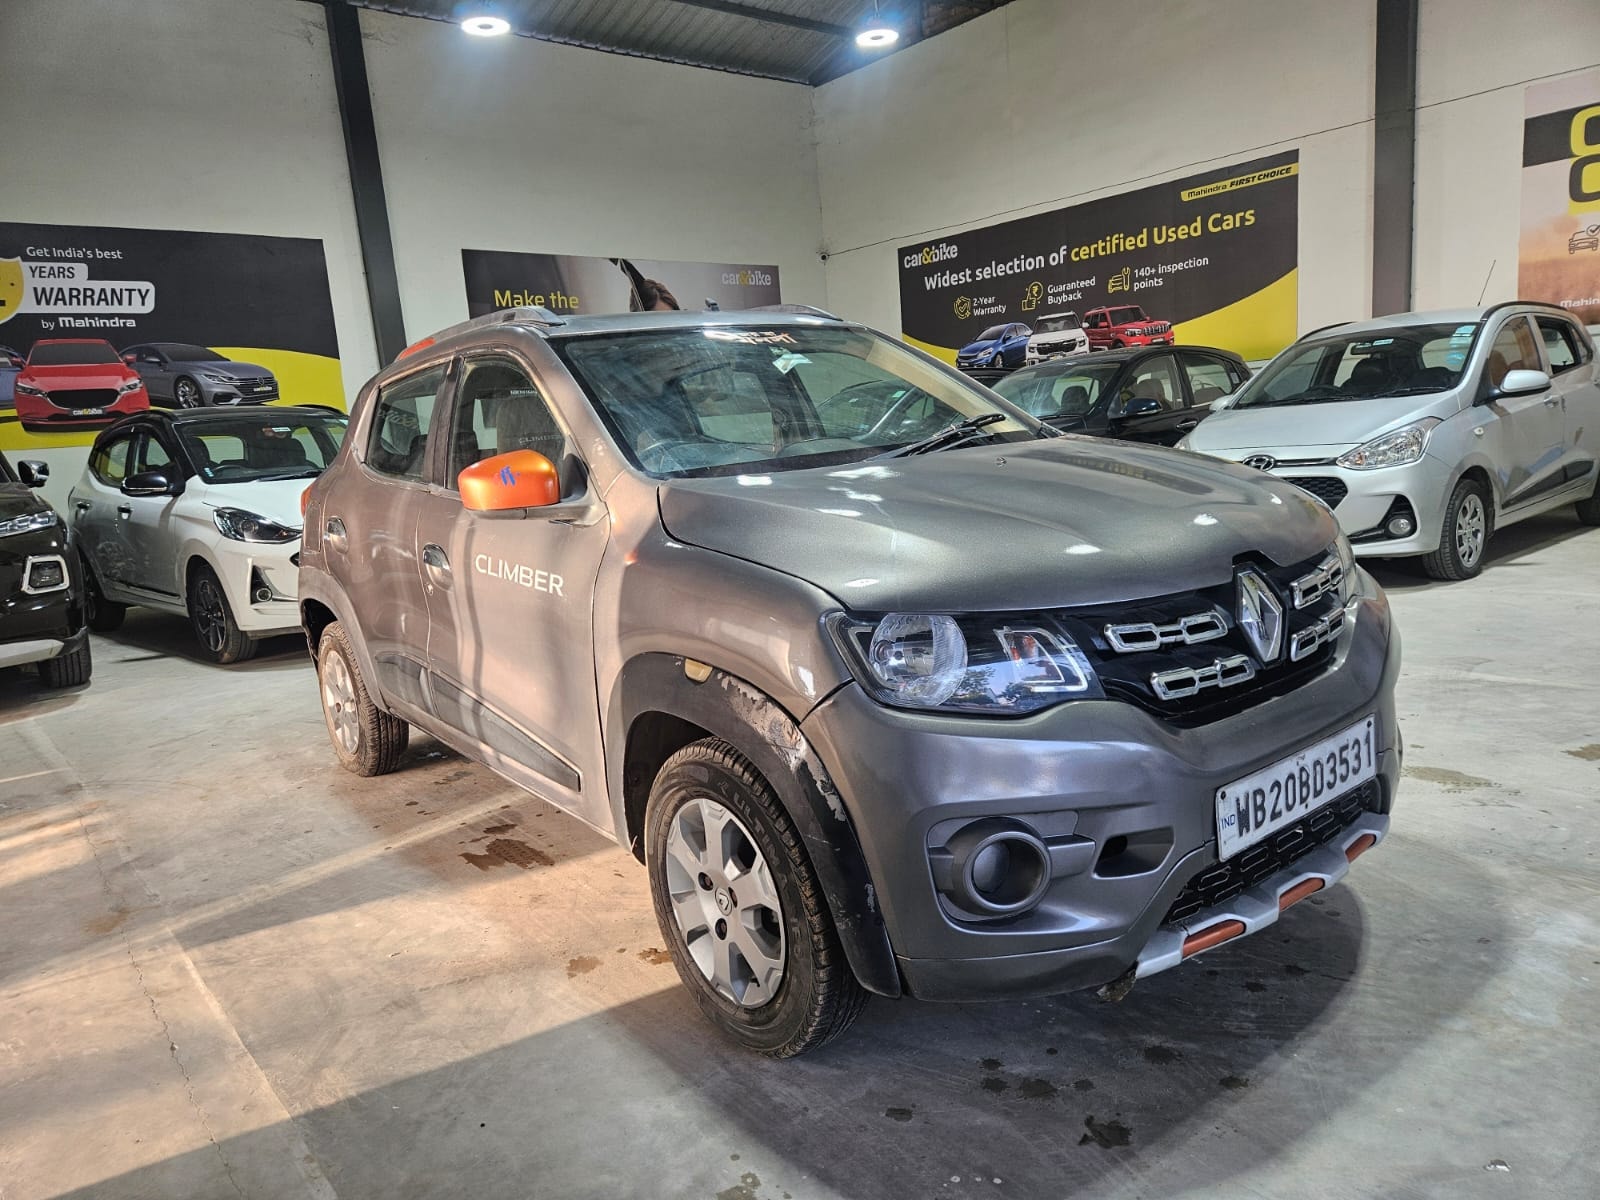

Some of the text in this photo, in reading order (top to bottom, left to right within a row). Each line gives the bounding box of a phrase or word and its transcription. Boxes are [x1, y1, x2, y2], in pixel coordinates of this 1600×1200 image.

[1188, 167, 1292, 199] Mahindra FIRST CHOICE
[26, 246, 123, 260] Get India's best
[904, 243, 958, 268] car&bike
[925, 209, 1256, 290] Widest selection of certified Used Cars
[29, 265, 76, 279] YEARS
[1134, 256, 1209, 279] 140+ inspection
[723, 270, 772, 287] car&bike
[1047, 278, 1096, 293] Guaranteed
[1133, 277, 1164, 292] points
[33, 286, 150, 307] WARRANTY
[494, 288, 580, 310] Make the
[973, 295, 995, 307] 2-Year
[1047, 291, 1082, 305] Buyback
[1560, 297, 1600, 308] Mahin
[973, 303, 1007, 317] Warranty
[41, 316, 136, 330] by Mahindra
[475, 554, 565, 596] CLIMBER
[1236, 731, 1373, 838] WB20BD3531
[1219, 814, 1236, 830] IND
